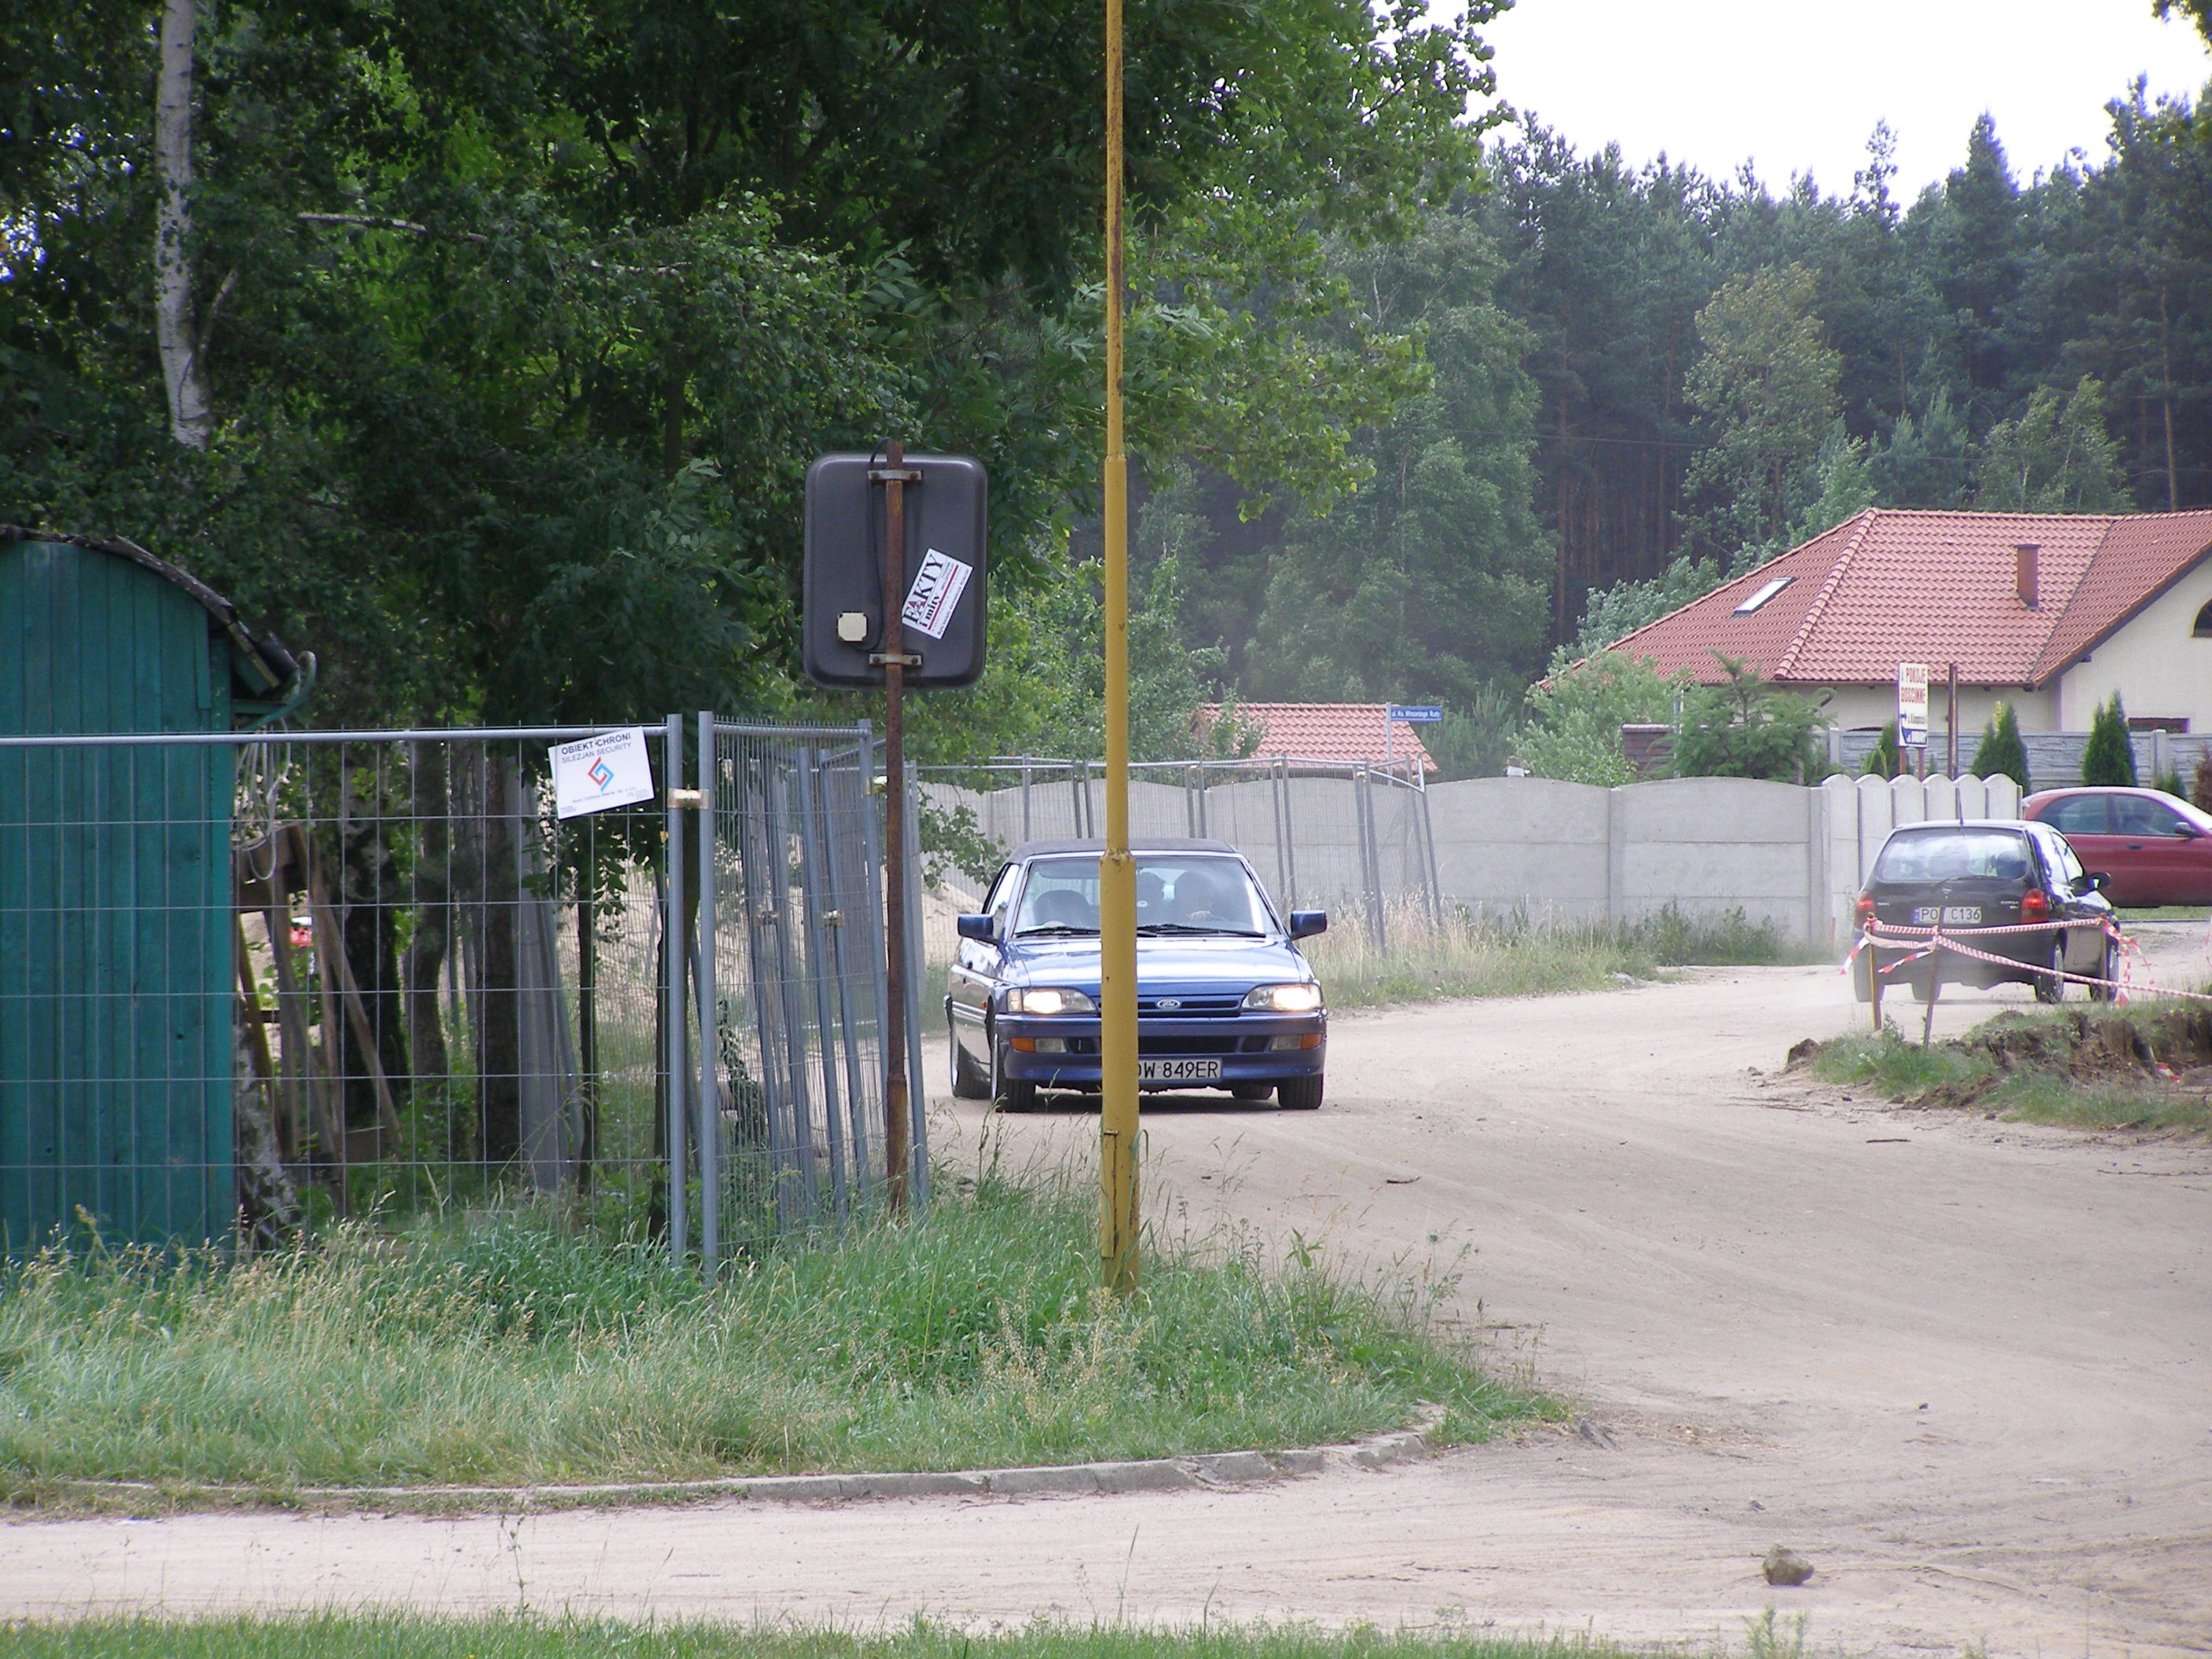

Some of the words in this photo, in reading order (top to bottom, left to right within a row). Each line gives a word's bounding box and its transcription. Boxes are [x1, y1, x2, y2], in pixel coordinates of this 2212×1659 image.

[903, 554, 943, 624] FAKTY
[925, 592, 943, 621] mity
[562, 742, 594, 755] OBIEKT
[597, 732, 632, 747] CHRONI
[562, 752, 595, 764] SILEZJAN
[597, 742, 632, 755] SECURITY
[1921, 908, 1939, 921] PO
[1951, 908, 1980, 921] C136
[1138, 1061, 1155, 1079] W
[1163, 1061, 1218, 1079] 849ER
